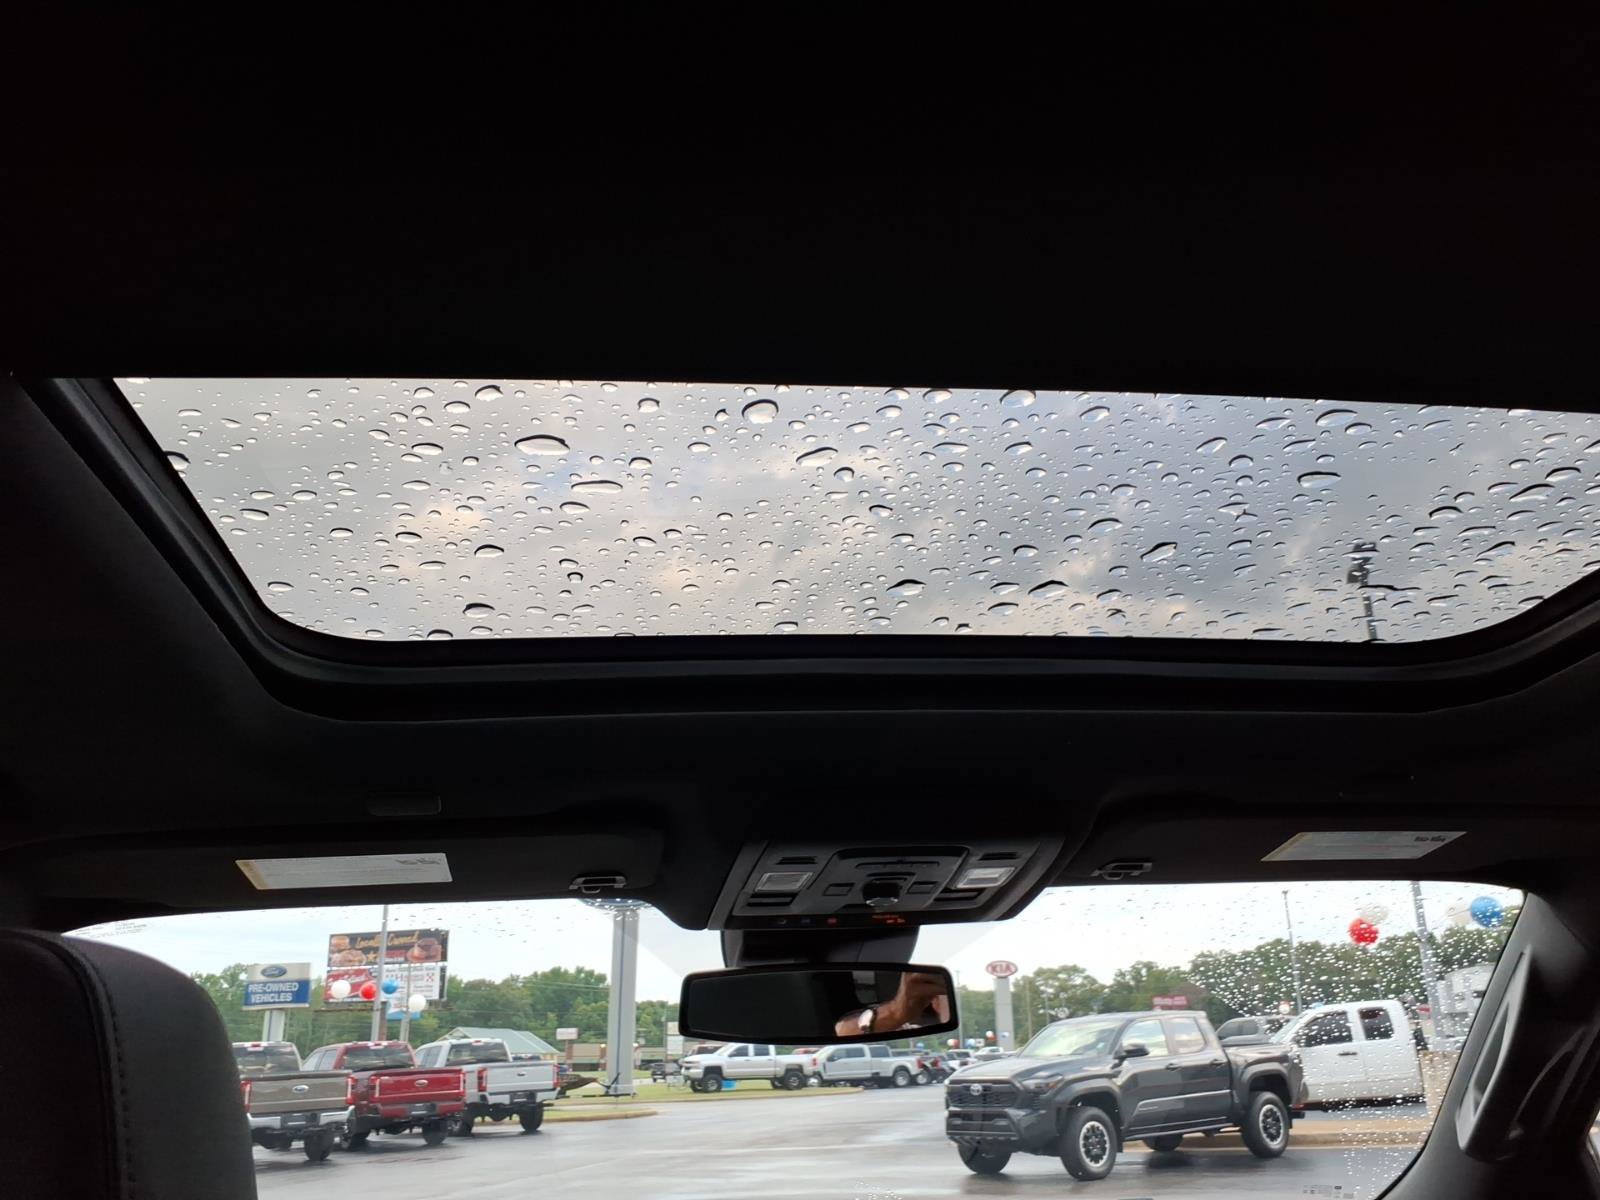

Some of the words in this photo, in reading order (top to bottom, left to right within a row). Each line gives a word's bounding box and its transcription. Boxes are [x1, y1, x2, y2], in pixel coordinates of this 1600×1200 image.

[991, 963, 1013, 974] KIA
[248, 982, 299, 993] PRE-OWNED
[251, 993, 293, 1003] VEHICLES
